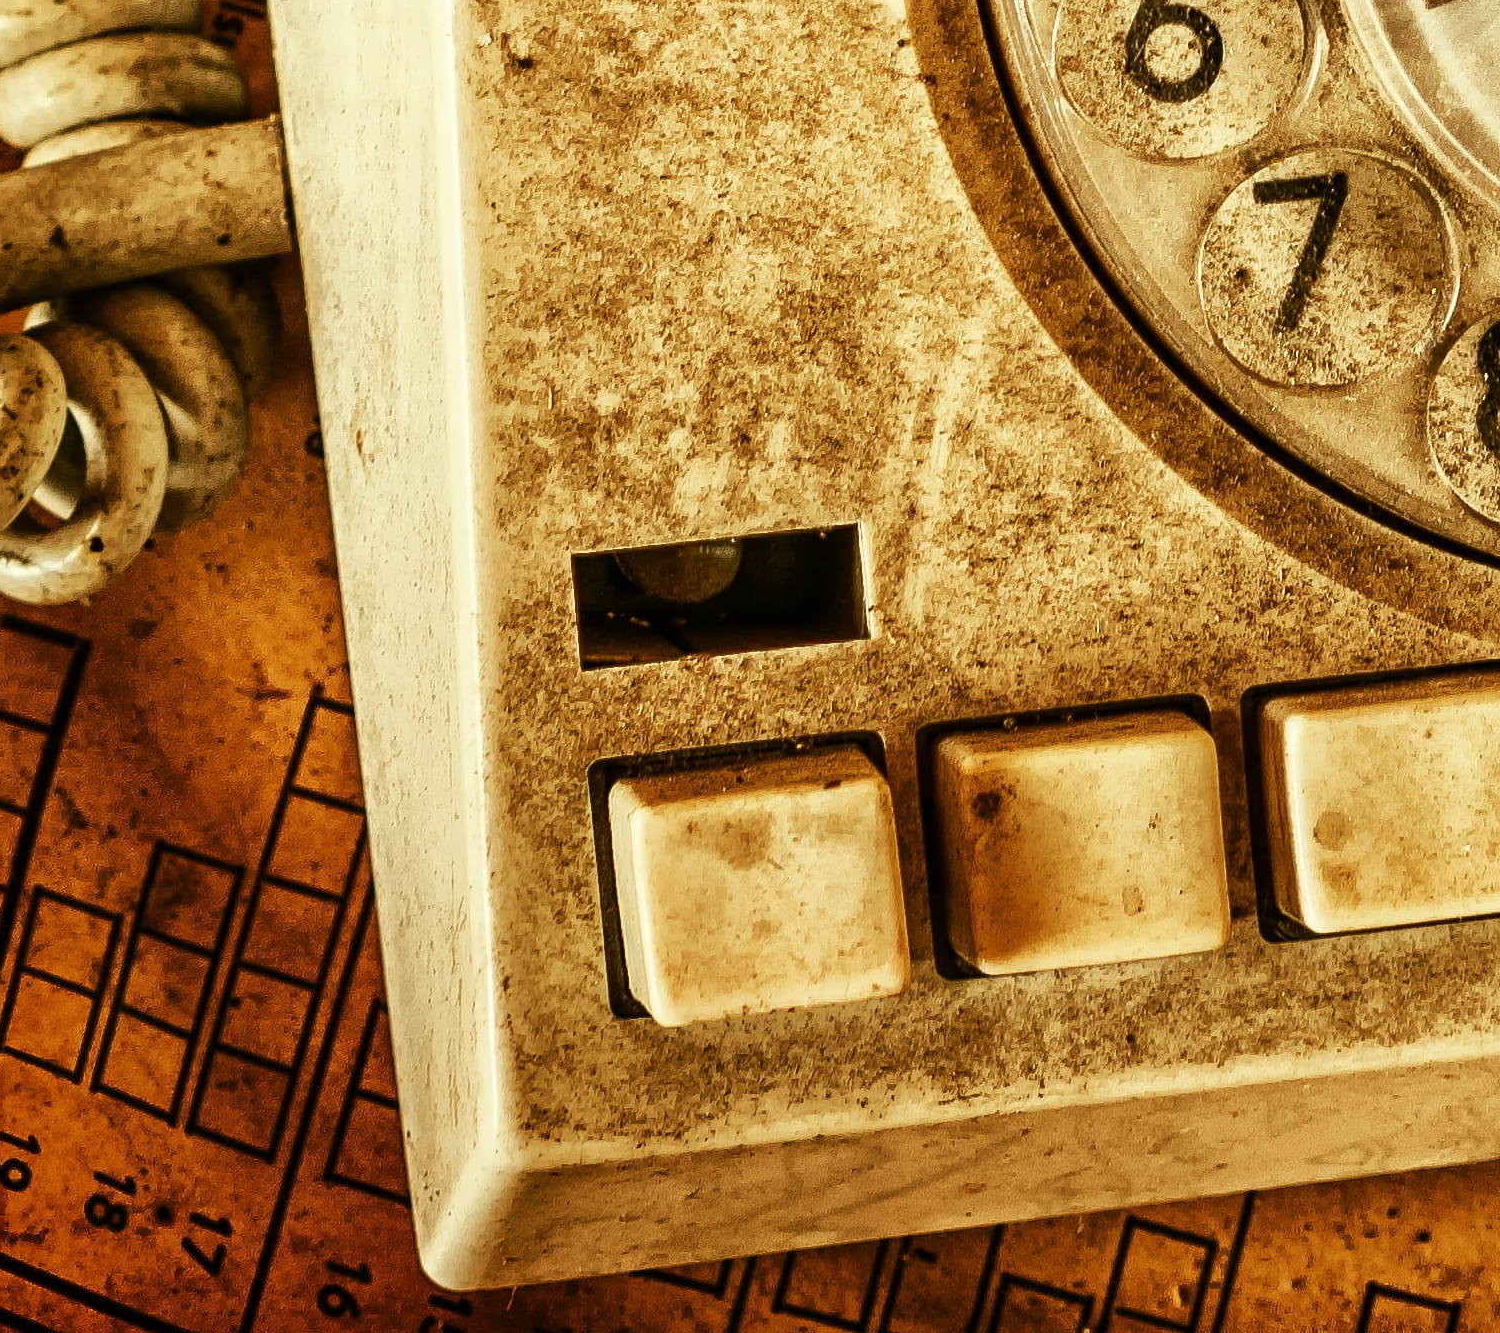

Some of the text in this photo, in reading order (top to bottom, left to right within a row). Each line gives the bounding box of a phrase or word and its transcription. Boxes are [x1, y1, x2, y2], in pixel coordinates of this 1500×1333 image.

[1252, 171, 1350, 335] 7
[83, 1169, 138, 1233] 18
[181, 1210, 234, 1277] 17
[316, 1259, 373, 1319] 16
